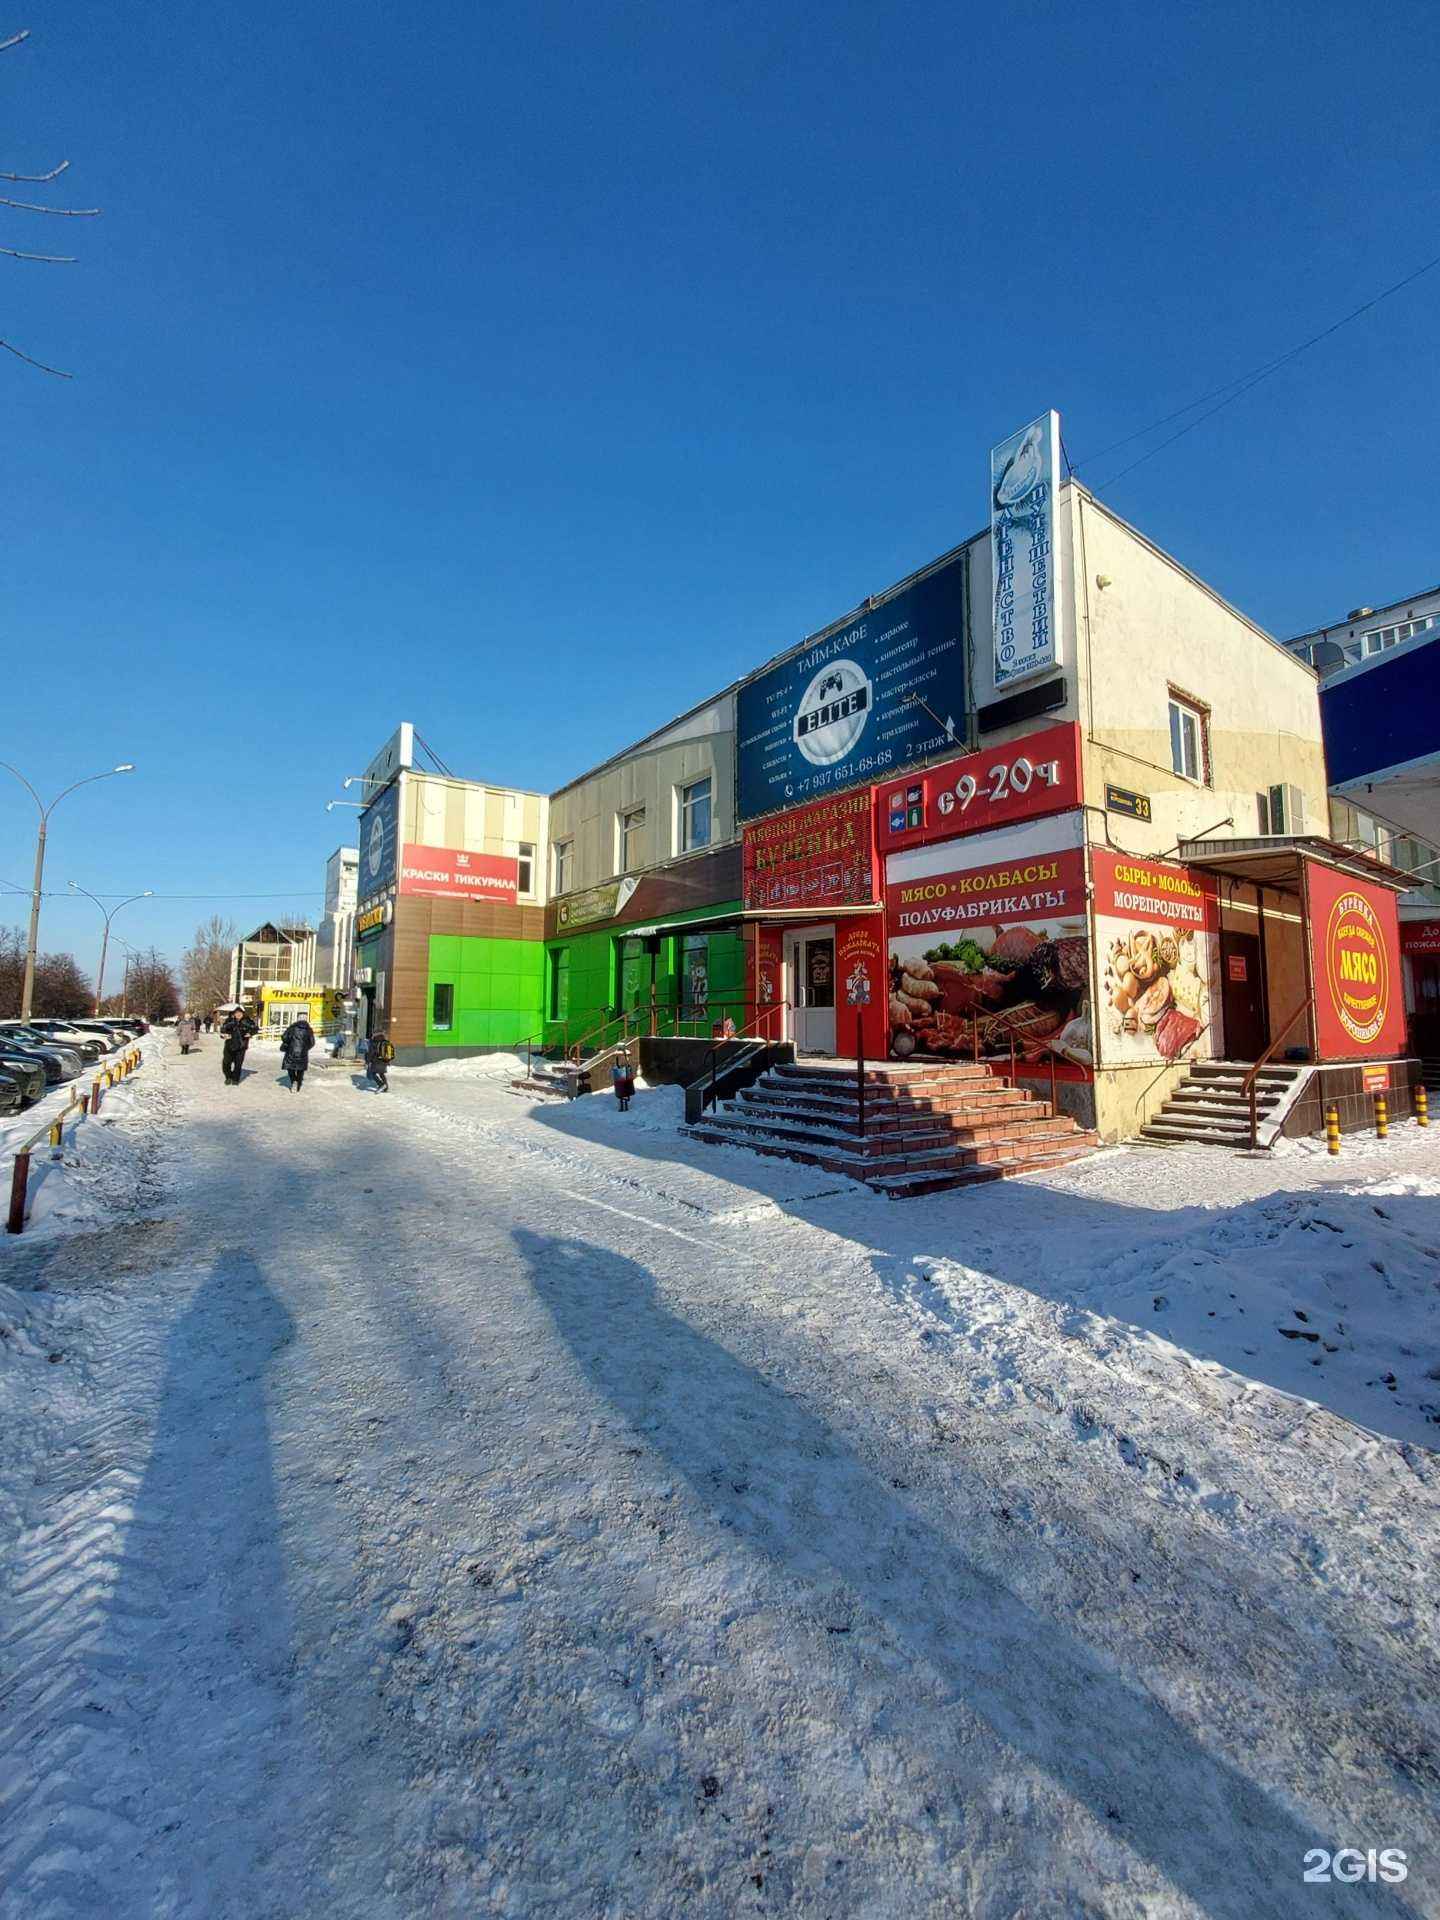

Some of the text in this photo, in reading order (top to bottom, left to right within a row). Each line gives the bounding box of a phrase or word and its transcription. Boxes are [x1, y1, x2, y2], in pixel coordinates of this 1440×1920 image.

[999, 508, 1016, 663] АГЕНТСТВО
[797, 624, 867, 674] ТАЙМ-КАФЕ
[880, 637, 918, 662] кинотеатр
[881, 668, 937, 699] мастер-классы
[807, 693, 858, 732] ELITE
[906, 734, 945, 757] 2 этаж
[797, 749, 893, 794] +7 937 651-68-68
[1135, 798, 1149, 817] 33
[402, 868, 516, 890] КРАСКИ ТИККУРИЛА
[900, 862, 1058, 904] МЯСО КОЛБАСЫ
[1114, 864, 1201, 897] СЫРЫ МОЛОКО
[899, 890, 1066, 927] ПОЛУФАБРИКАТЫ
[1114, 891, 1203, 922] МОРЕПРОДУКТЫ
[1340, 949, 1377, 985] МЯСО
[272, 989, 326, 1000] Пекарня
